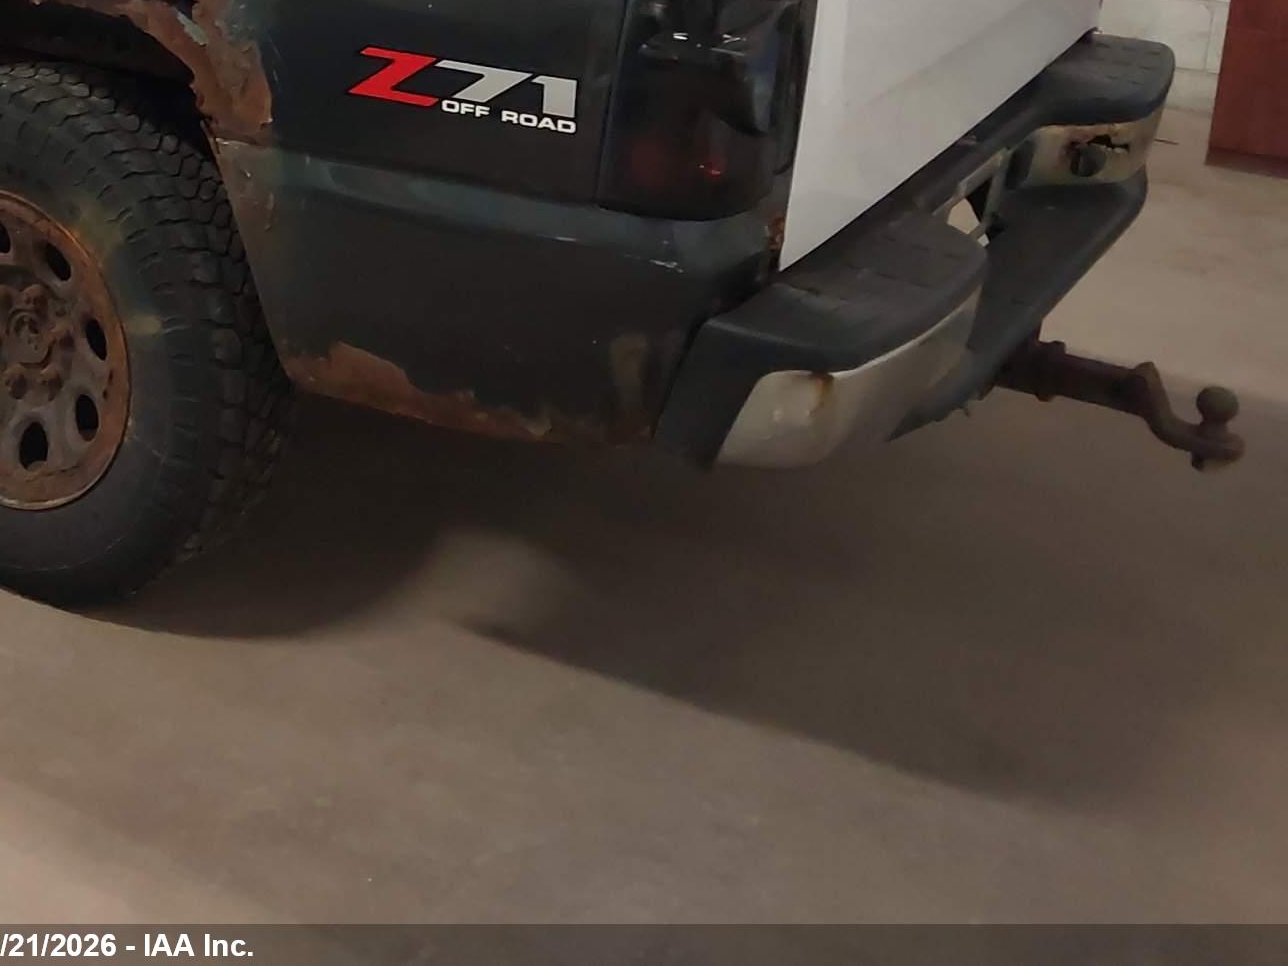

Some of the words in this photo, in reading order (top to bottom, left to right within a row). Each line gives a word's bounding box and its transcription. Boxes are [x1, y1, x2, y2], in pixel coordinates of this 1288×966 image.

[348, 46, 578, 119] Z71
[441, 99, 490, 118] OFF
[501, 110, 577, 134] ROAD
